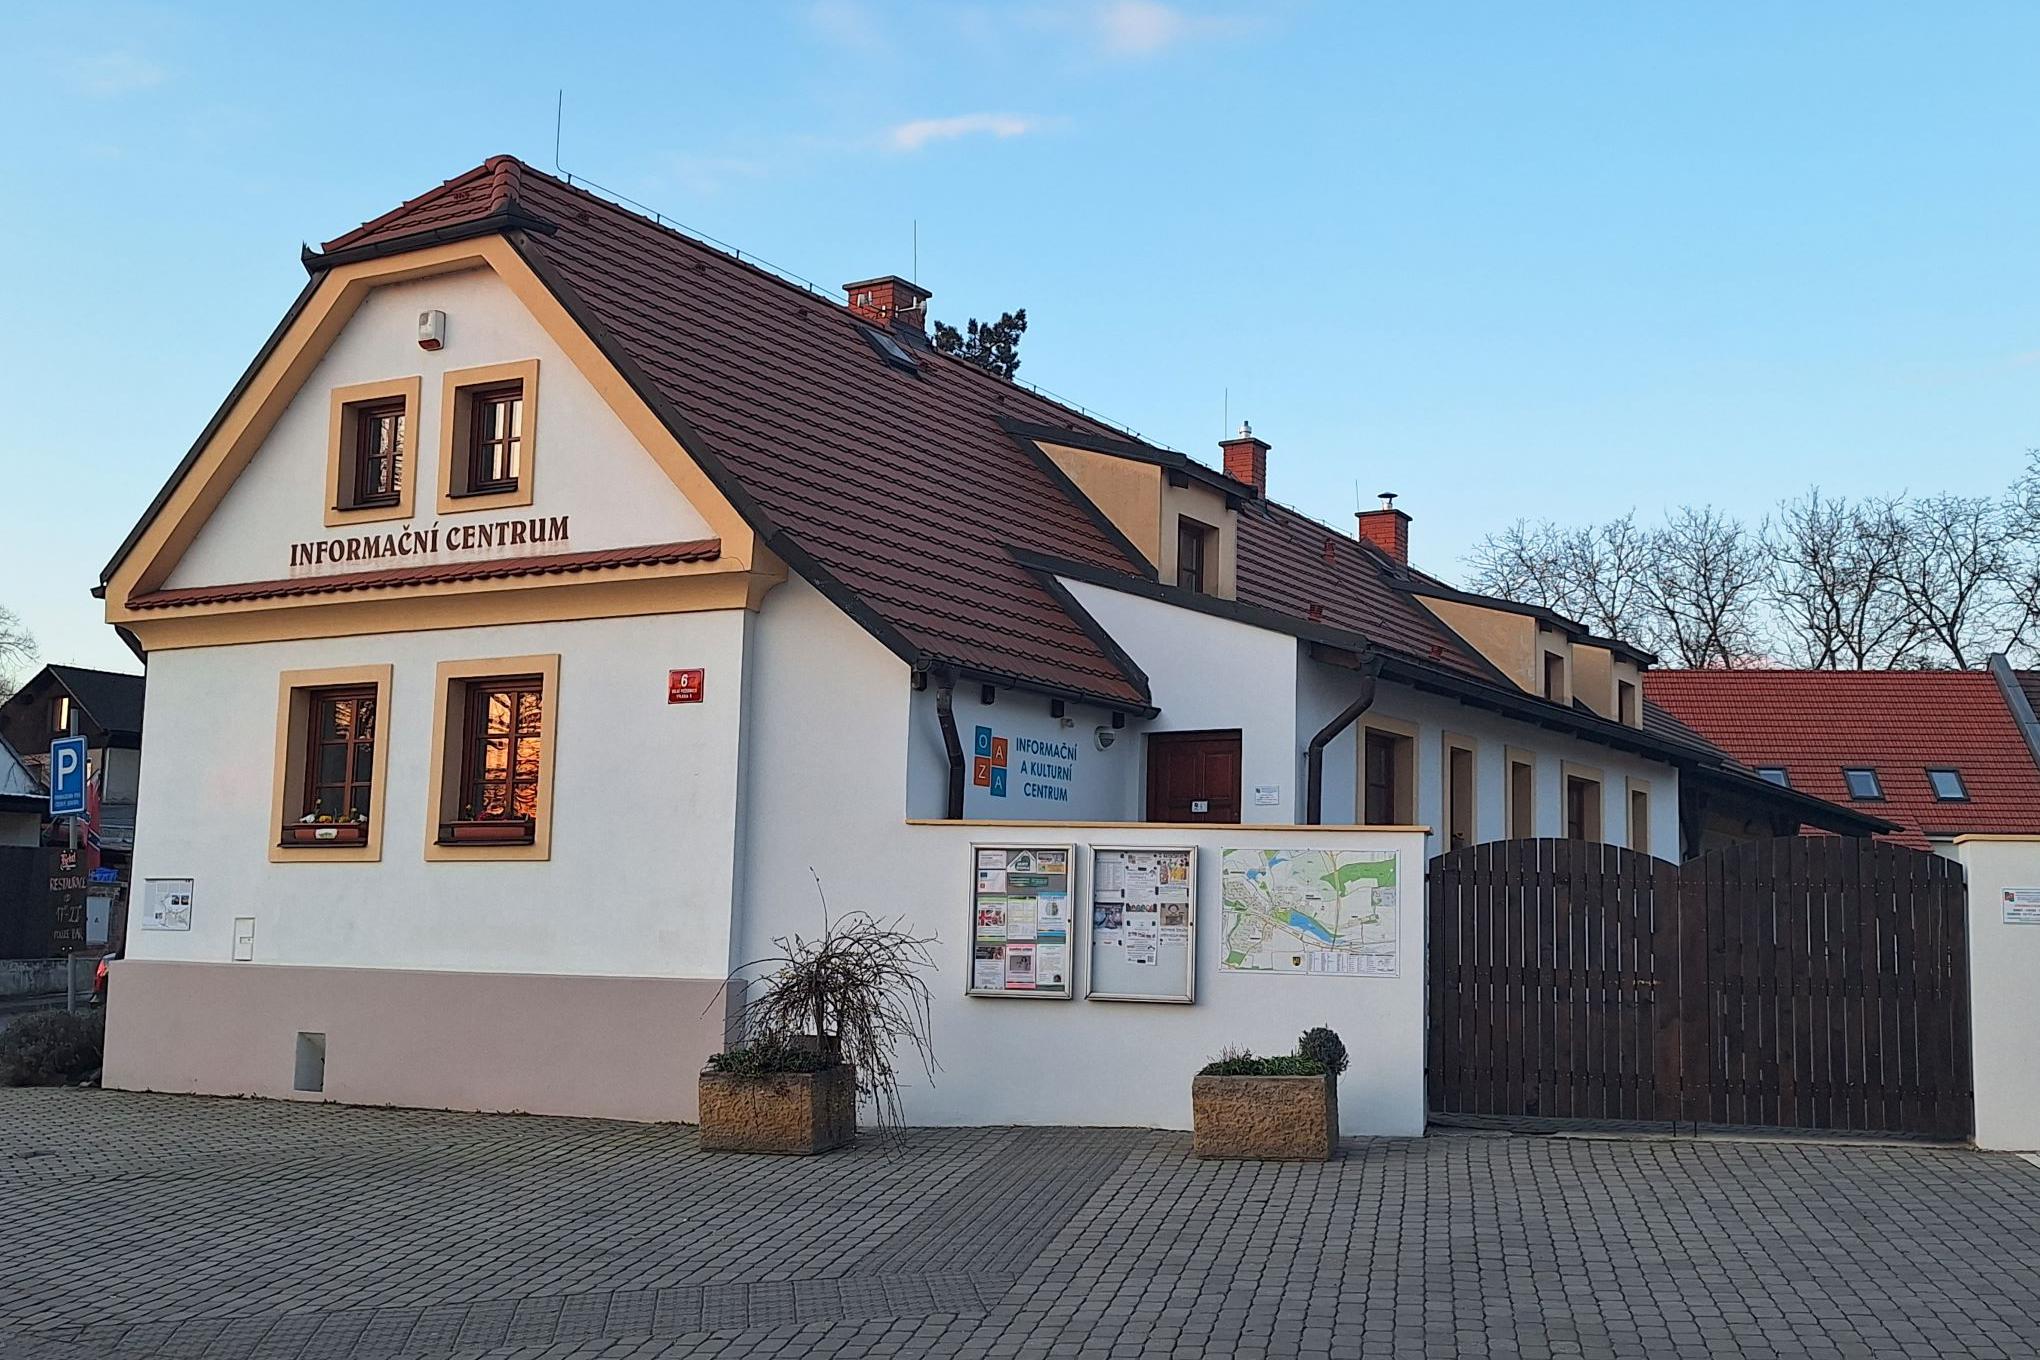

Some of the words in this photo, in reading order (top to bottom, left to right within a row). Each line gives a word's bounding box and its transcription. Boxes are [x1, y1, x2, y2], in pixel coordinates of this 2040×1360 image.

[290, 521, 439, 567] INFORMAČNÍ
[446, 516, 569, 551] CENTRUM
[681, 674, 688, 687] 6
[979, 734, 988, 749] O
[996, 746, 1004, 760] A
[1016, 737, 1078, 760] INFORMAČNÍ
[58, 748, 78, 791] P
[979, 765, 986, 779] Z
[995, 776, 1003, 790] A
[1021, 760, 1028, 774] A
[1031, 761, 1072, 782] KULTURNÍ
[1023, 782, 1068, 802] CENTRUM
